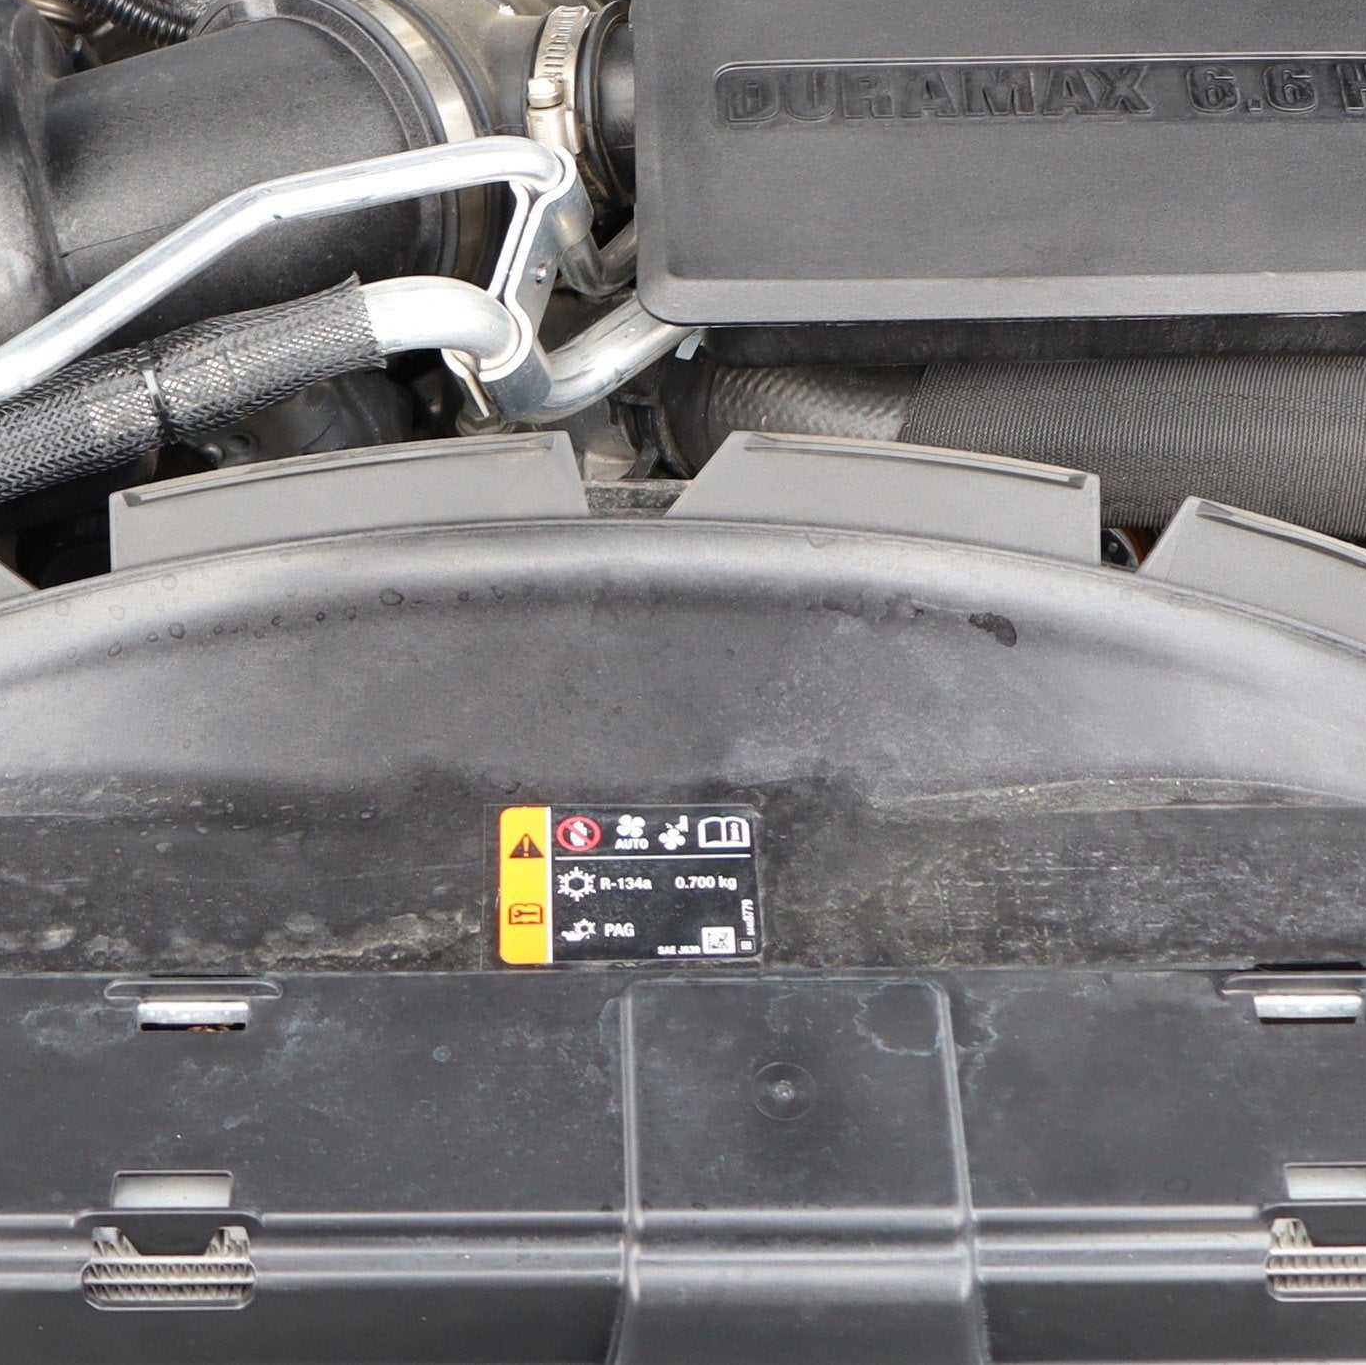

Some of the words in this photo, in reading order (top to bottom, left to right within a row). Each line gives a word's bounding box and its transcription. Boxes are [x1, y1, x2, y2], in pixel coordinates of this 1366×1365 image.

[728, 64, 1152, 125] DURAMAX
[1186, 63, 1318, 115] 6.6
[614, 837, 650, 850] AUTO
[600, 876, 653, 891] R-134a
[675, 875, 716, 890] 0.700
[718, 875, 738, 892] kg
[604, 922, 635, 938] PAG
